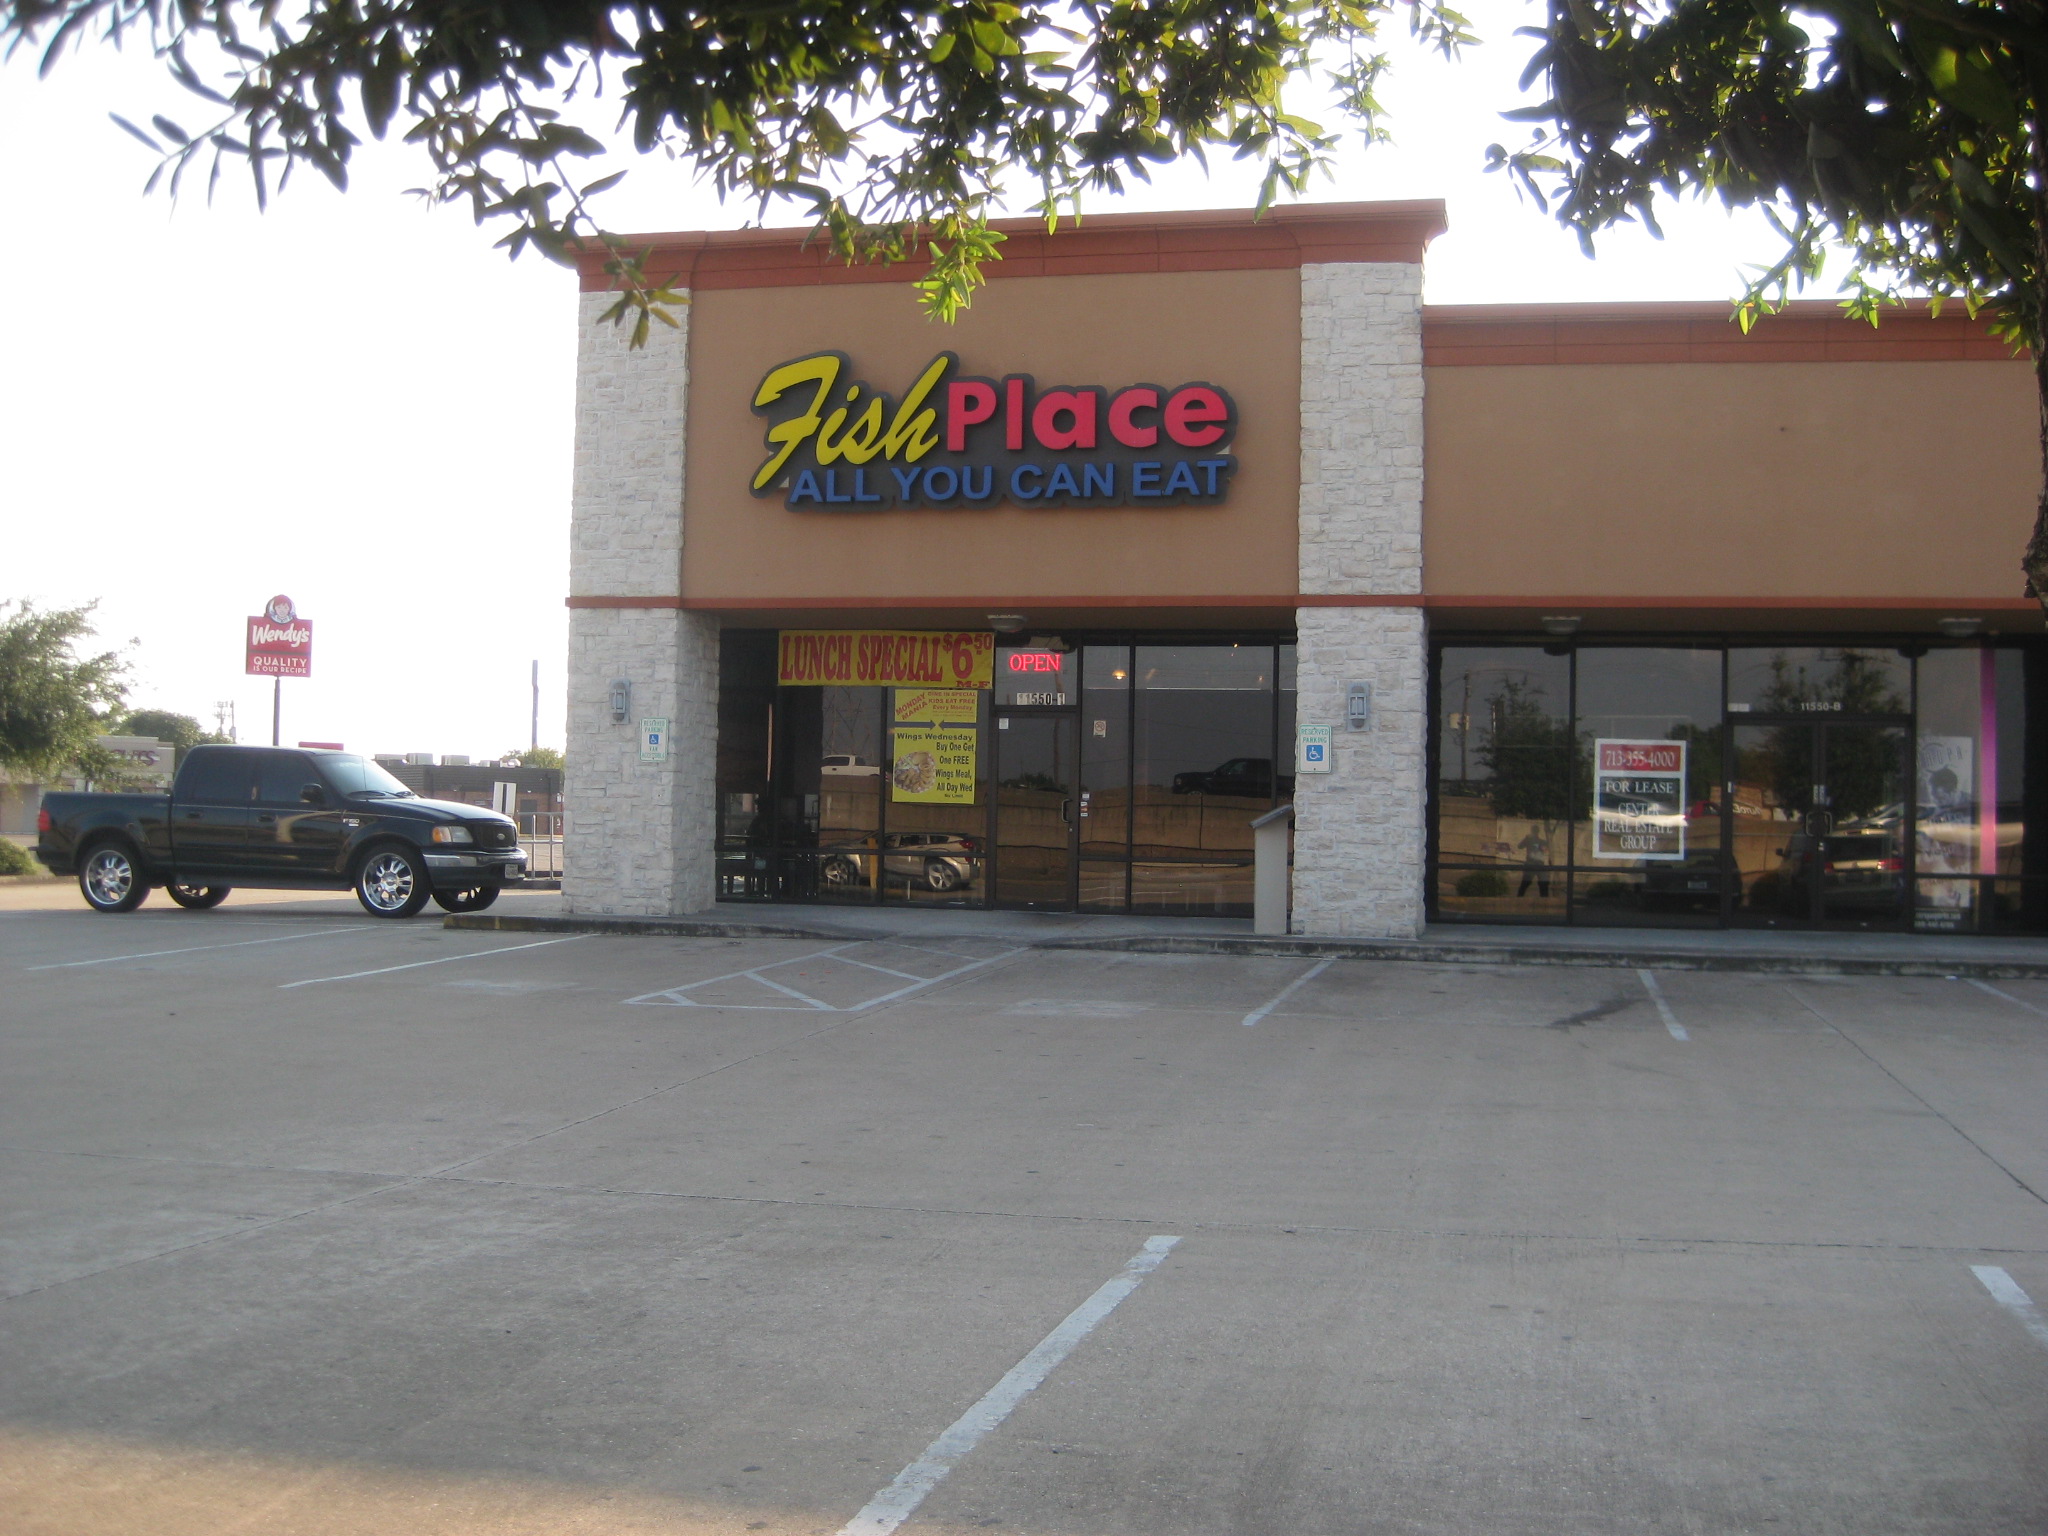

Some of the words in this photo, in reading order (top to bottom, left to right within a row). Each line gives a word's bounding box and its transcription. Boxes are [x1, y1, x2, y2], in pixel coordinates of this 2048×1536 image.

[754, 355, 949, 489] Fish
[947, 379, 1228, 451] Place
[789, 468, 881, 503] ALL
[890, 464, 994, 502] YOU
[1010, 463, 1114, 499] CAN
[1132, 460, 1228, 497] EAT
[252, 623, 310, 648] Wendy's
[253, 656, 307, 667] QUALITY
[780, 635, 852, 681] LUNCH
[857, 635, 943, 682] SPECIAL
[1009, 653, 1062, 672] OPEN
[280, 666, 307, 674] RECIPE
[896, 693, 925, 715] MONDAY
[901, 702, 928, 720] MANIA
[897, 733, 922, 741] Wings
[925, 733, 973, 742] Wednesday
[936, 742, 948, 752] Buy
[963, 743, 974, 752] Get
[939, 756, 951, 764] One
[953, 756, 969, 764] FREE
[1606, 750, 1675, 767] 713-355-4000
[935, 769, 953, 780] Wings
[937, 782, 945, 792] All
[947, 783, 958, 793] Day
[960, 783, 972, 792] Wed
[1605, 780, 1630, 793] FOR
[1635, 781, 1674, 793] LEASE
[1620, 835, 1656, 849] GROUP
